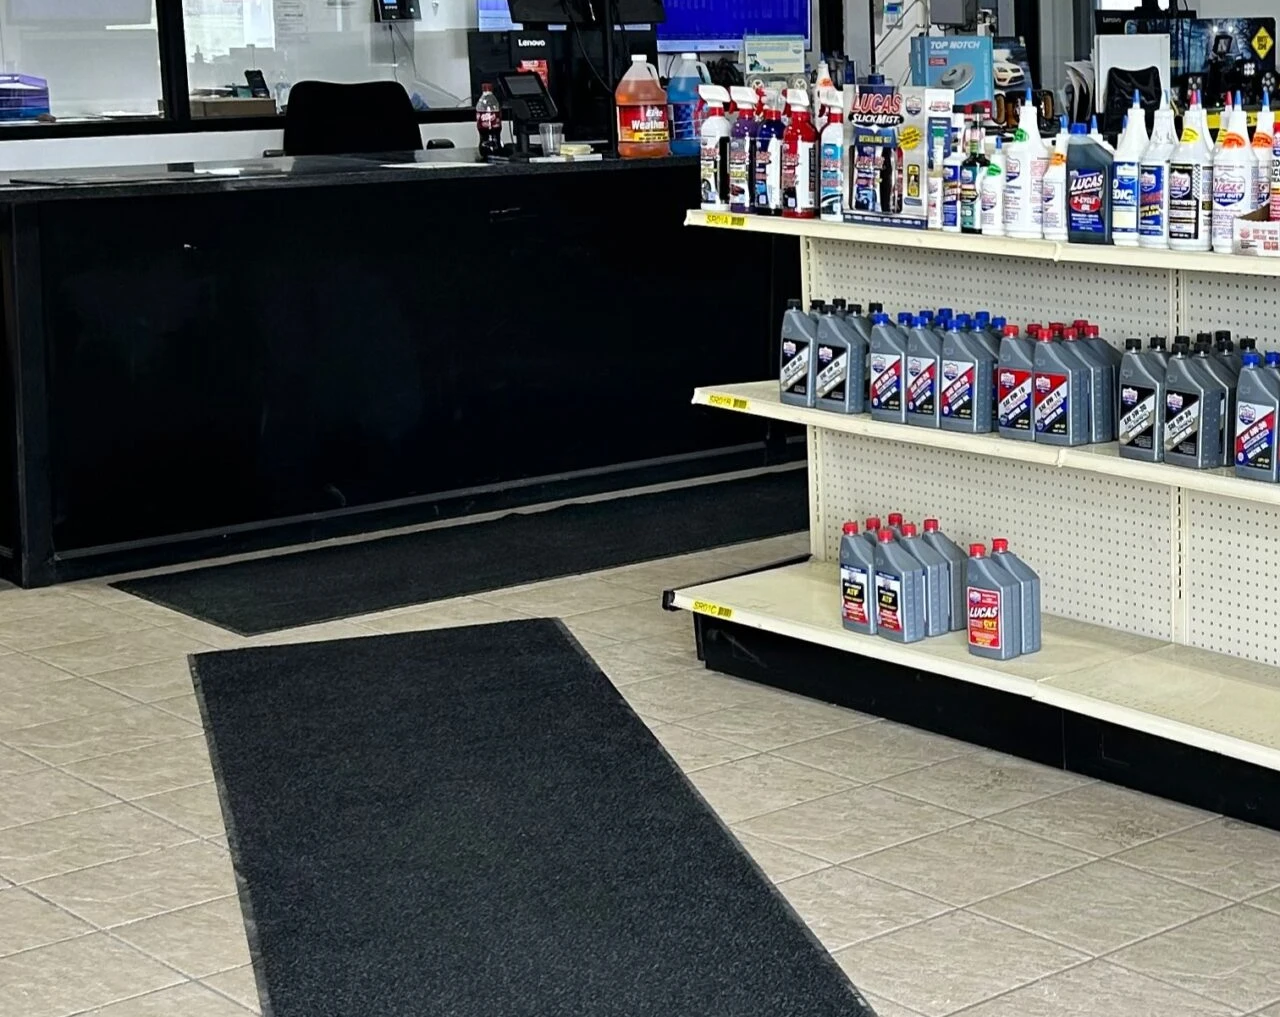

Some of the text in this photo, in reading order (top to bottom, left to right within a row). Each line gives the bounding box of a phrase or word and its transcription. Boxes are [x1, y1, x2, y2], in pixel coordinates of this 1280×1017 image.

[931, 41, 980, 49] TOP NOTCH
[851, 93, 902, 113] LUCAS
[1070, 175, 1103, 191] LUCAS
[847, 588, 859, 596] ATF
[882, 595, 893, 604] ATF
[970, 607, 998, 618] LUCAS
